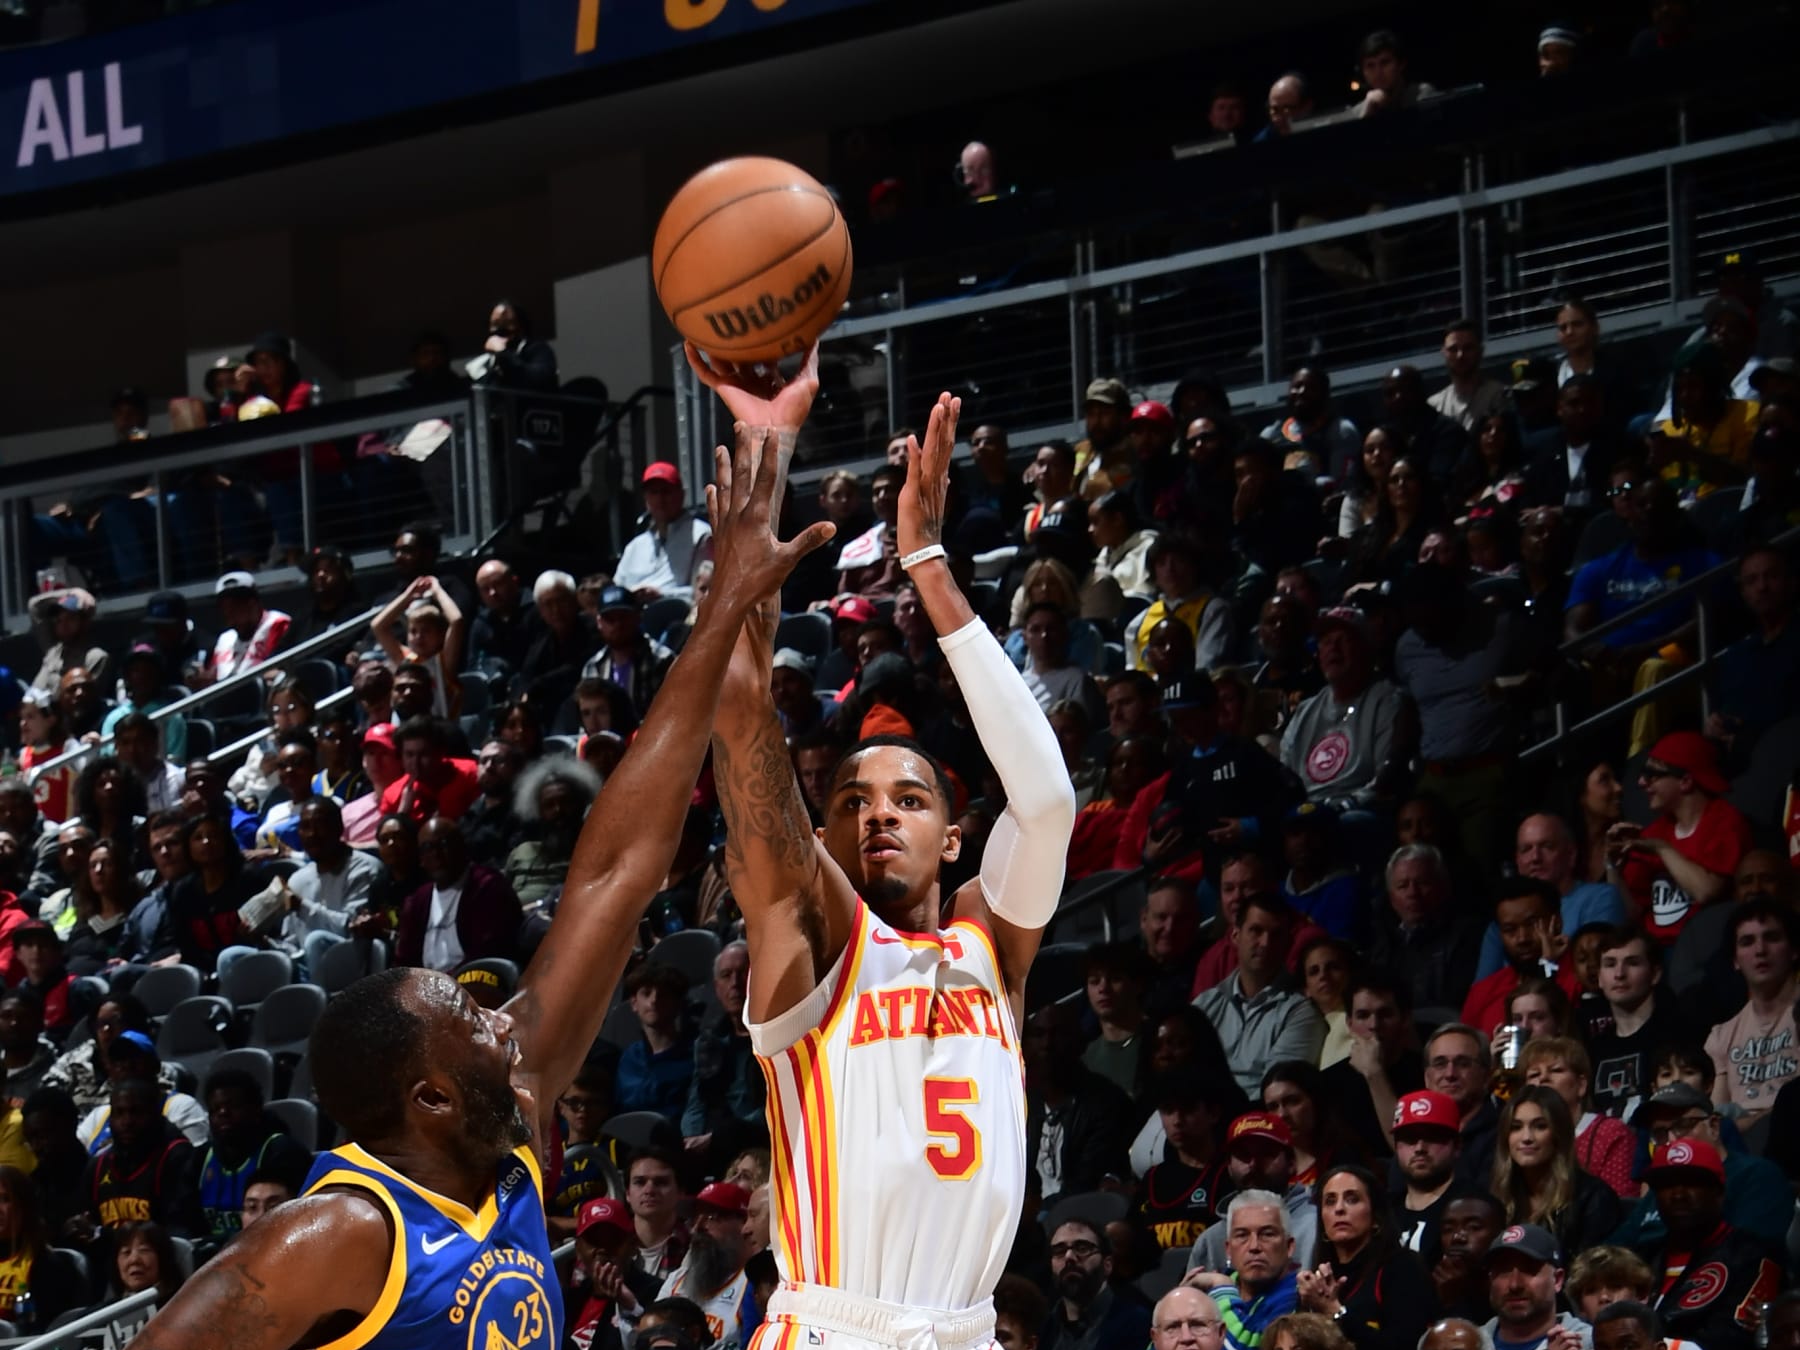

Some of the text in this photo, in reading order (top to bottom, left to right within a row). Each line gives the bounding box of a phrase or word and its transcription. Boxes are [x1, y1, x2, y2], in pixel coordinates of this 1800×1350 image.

[17, 62, 143, 167] ALL
[704, 263, 831, 339] Wilson
[1212, 761, 1236, 781] atl
[849, 985, 1010, 1050] ATLANT
[922, 1076, 983, 1181] 5
[494, 1248, 545, 1279] STATE
[513, 1292, 543, 1348] 23
